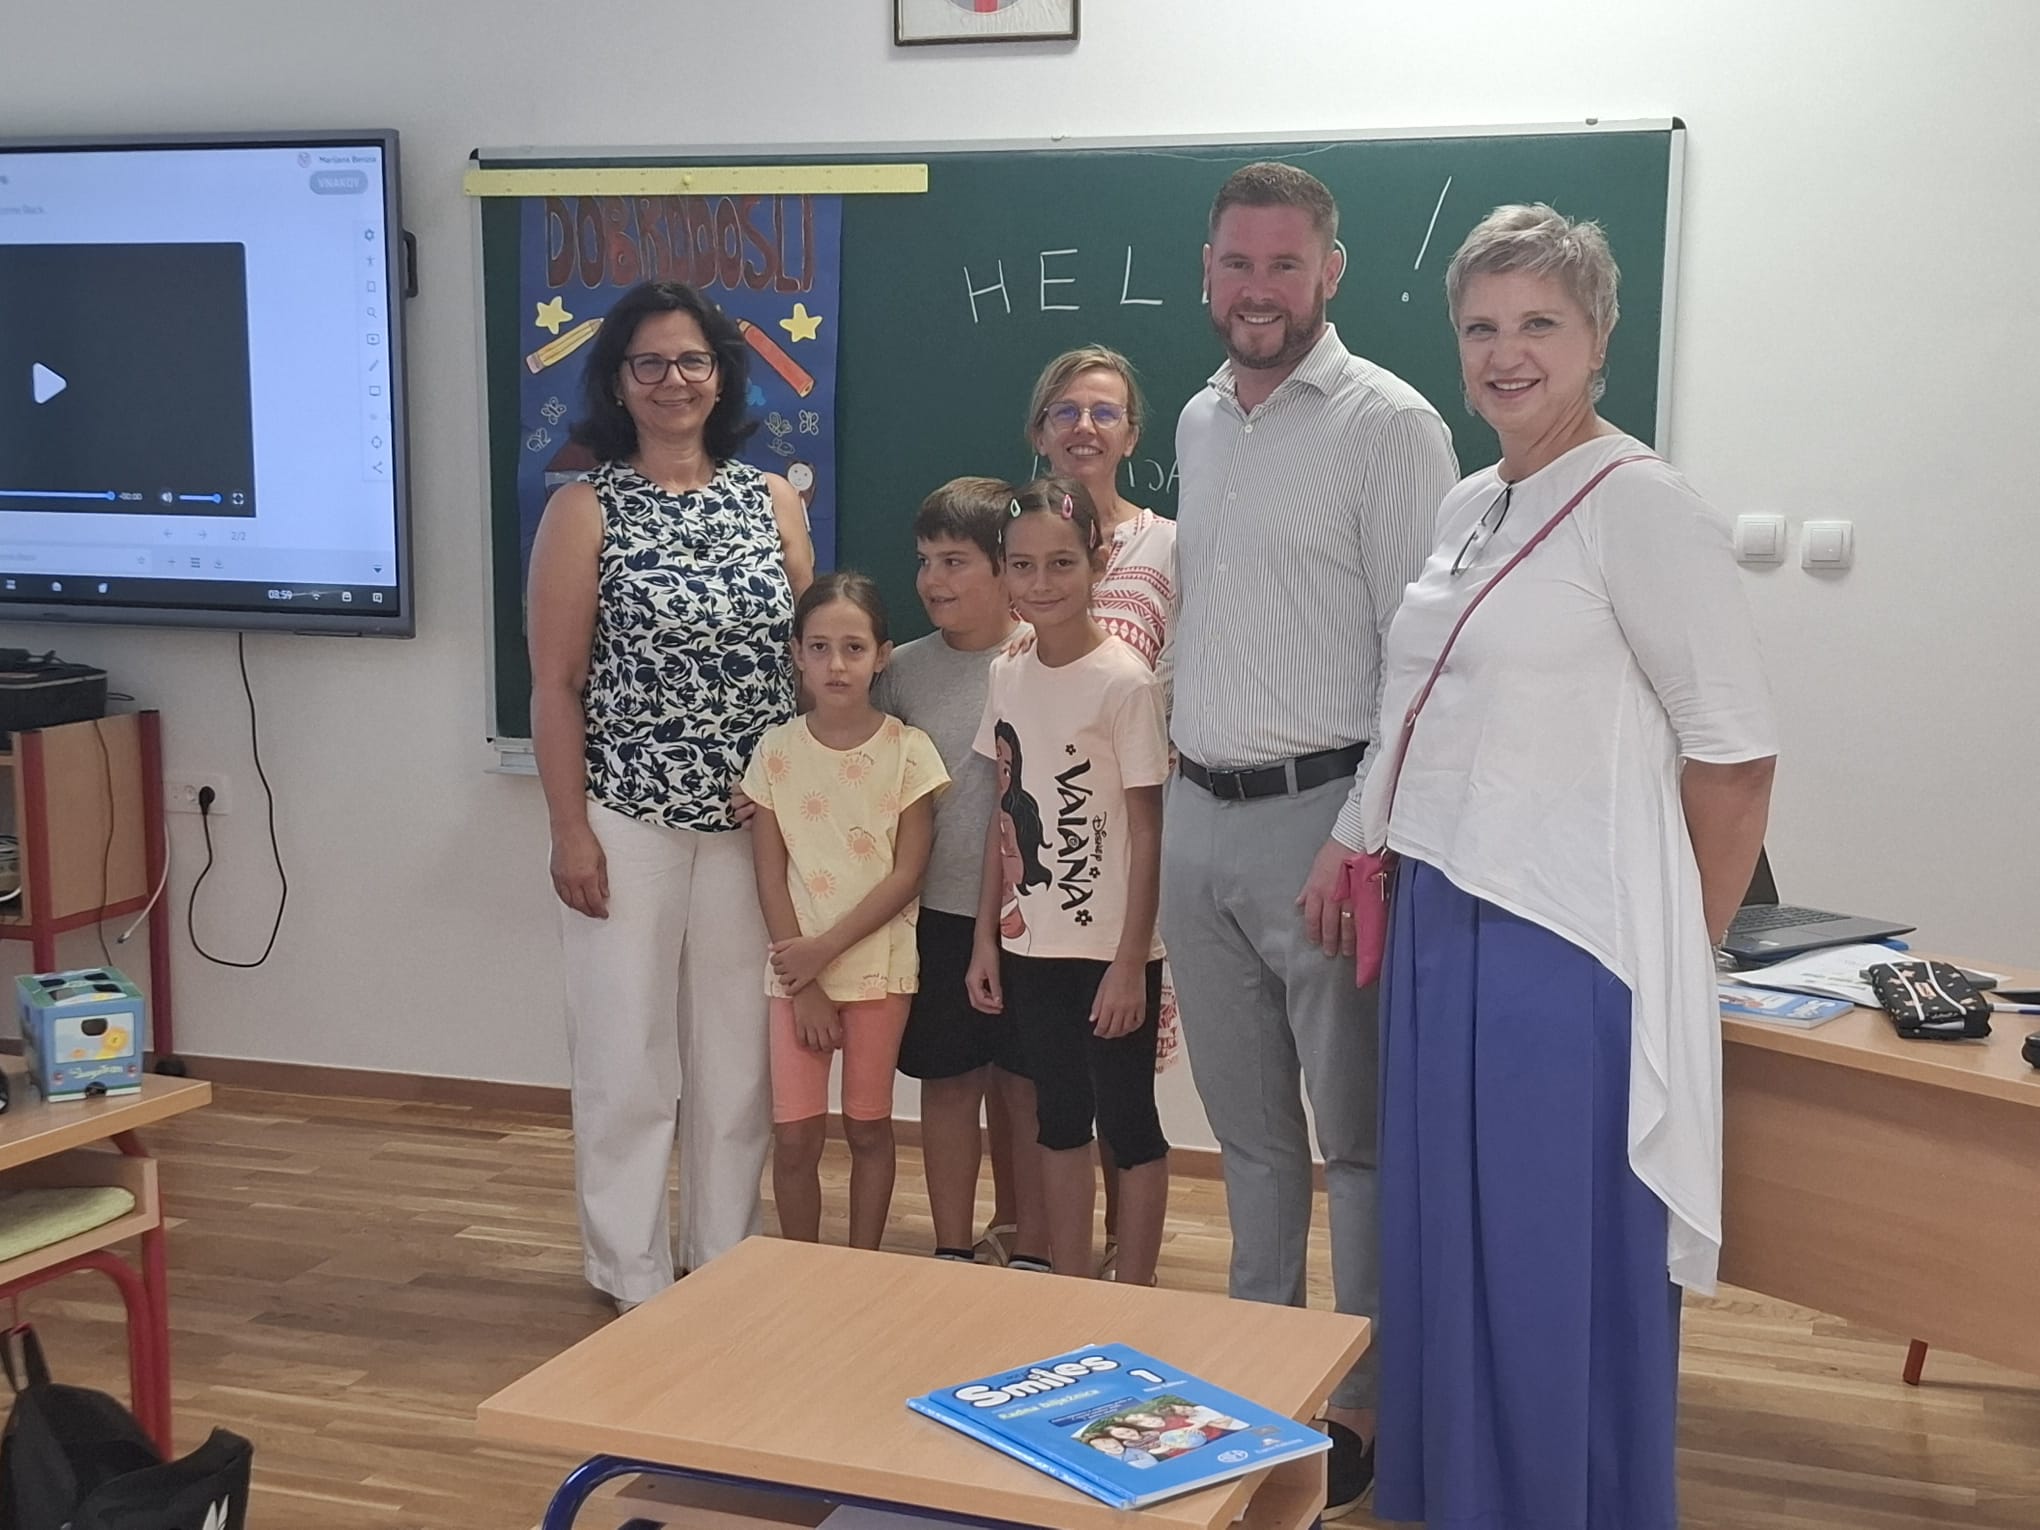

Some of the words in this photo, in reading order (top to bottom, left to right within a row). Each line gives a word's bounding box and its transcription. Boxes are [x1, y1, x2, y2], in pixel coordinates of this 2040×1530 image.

[1054, 757, 1094, 911] VAIANA
[1089, 811, 1107, 862] Disney
[955, 1355, 1121, 1408] Smiles
[1127, 1367, 1166, 1384] 1
